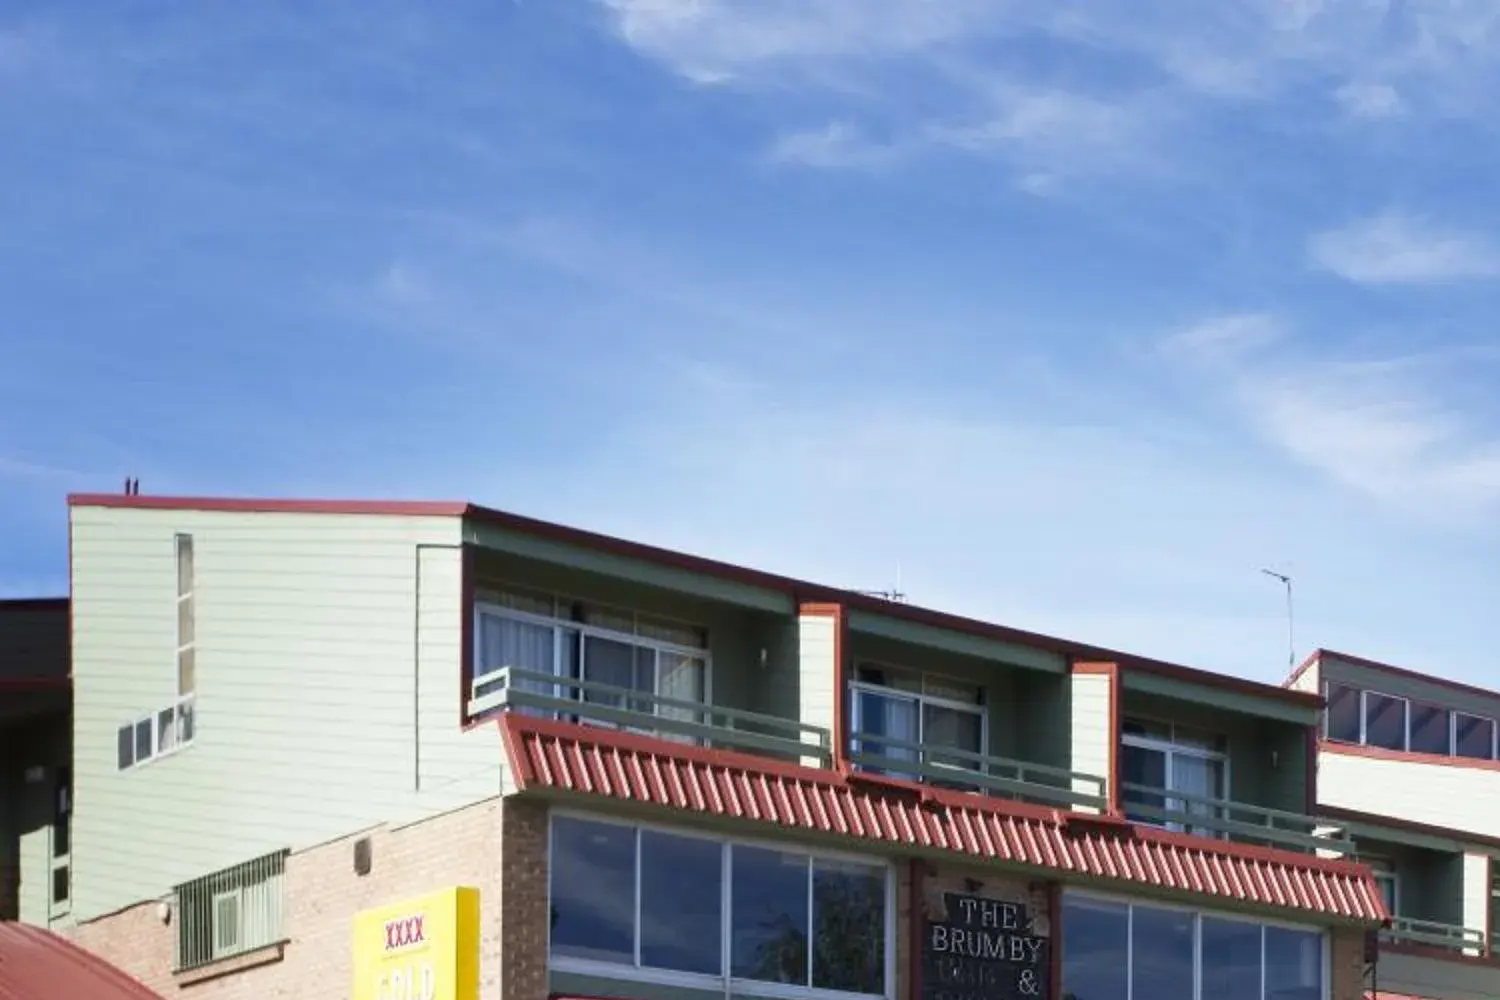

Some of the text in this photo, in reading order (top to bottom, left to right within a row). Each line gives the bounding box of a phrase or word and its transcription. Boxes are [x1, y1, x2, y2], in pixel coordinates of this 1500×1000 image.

[960, 899, 1017, 929] THE
[384, 915, 425, 950] XXXX
[932, 925, 1044, 962] BRUMBY
[1018, 968, 1040, 996] &
